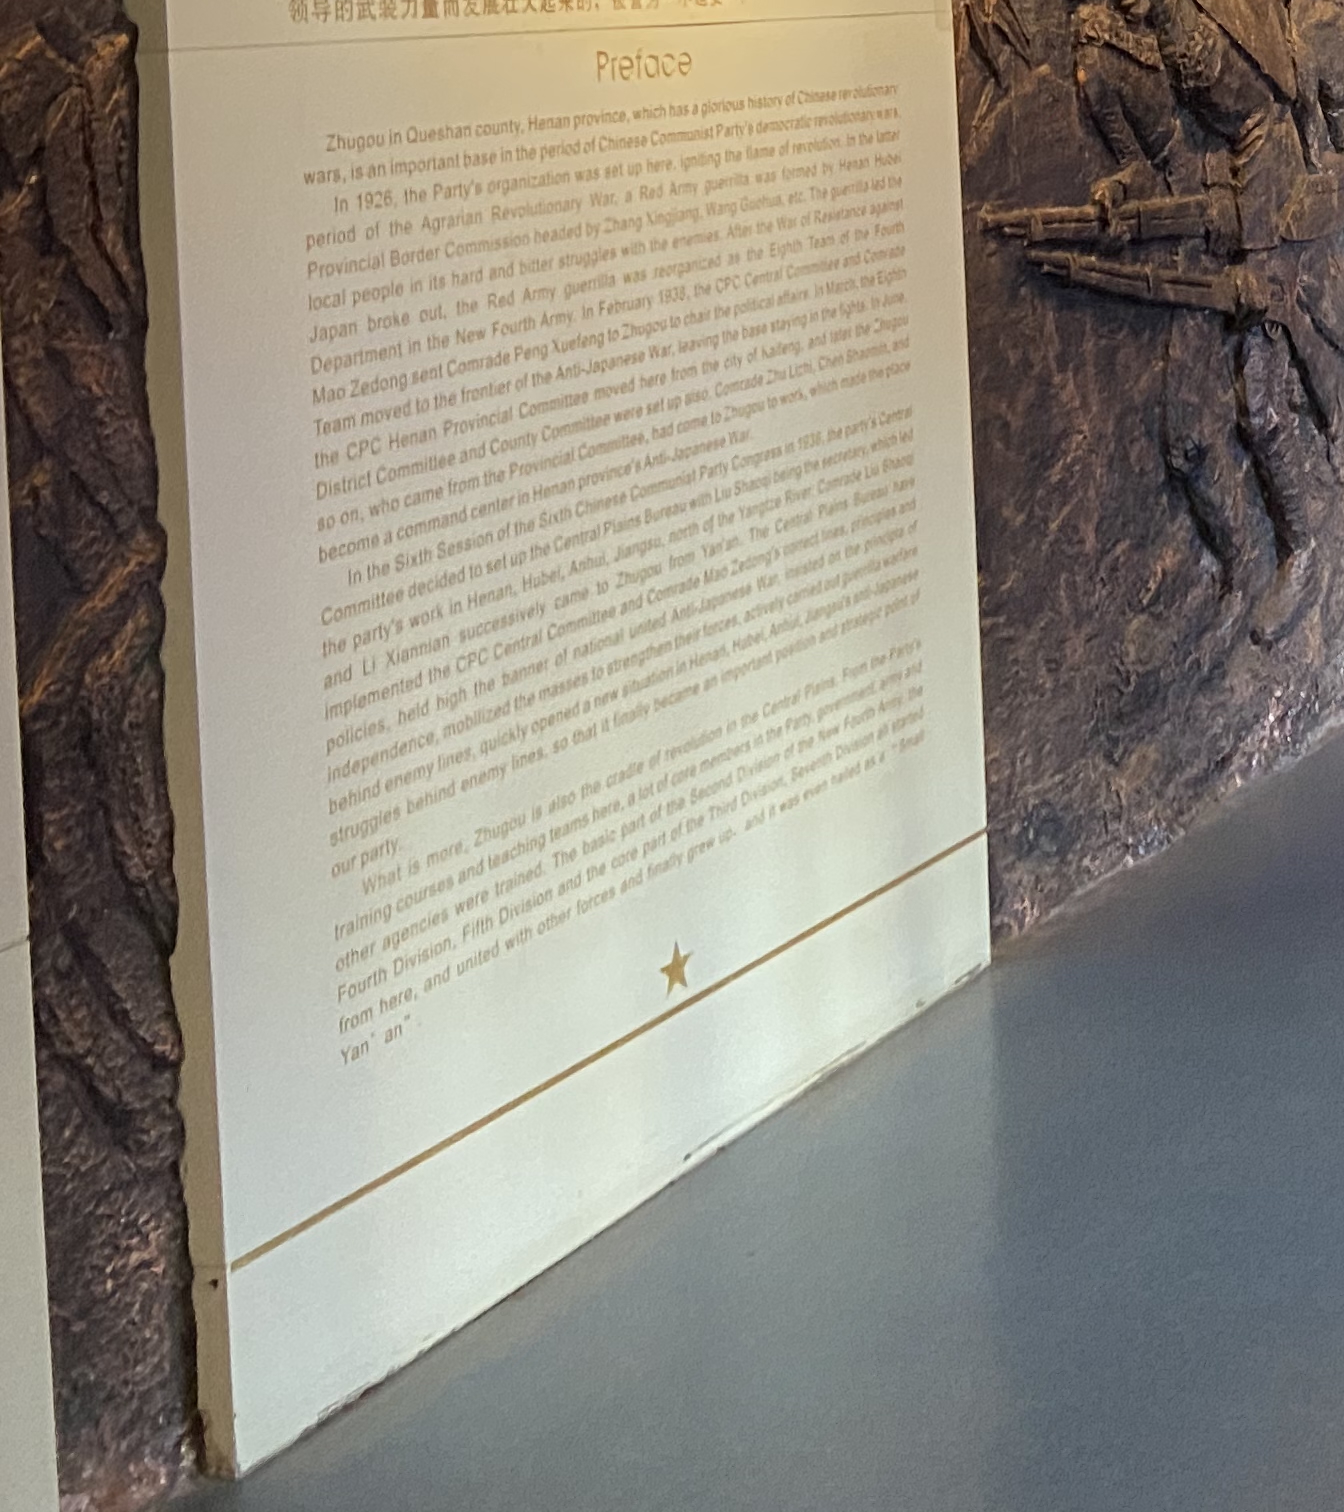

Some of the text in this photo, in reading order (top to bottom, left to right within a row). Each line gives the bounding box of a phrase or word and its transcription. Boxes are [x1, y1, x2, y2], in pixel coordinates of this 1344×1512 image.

[596, 44, 692, 83] Preface
[326, 133, 384, 153] Zhugou
[406, 123, 471, 144] Queshan
[390, 153, 459, 177] important
[463, 150, 496, 166] base
[488, 169, 569, 195] organization
[305, 224, 355, 252] period
[422, 209, 482, 234] Agrarian
[491, 198, 581, 221] Revolutionary
[307, 251, 384, 279] Provincial
[390, 245, 439, 266] Border
[445, 231, 529, 257] Commission
[307, 288, 345, 311] local
[352, 280, 403, 308] people
[309, 322, 357, 343] Japan
[368, 309, 409, 331] broke
[310, 340, 401, 373] Department
[492, 313, 535, 337] Fourth
[350, 373, 407, 396] Zedong
[412, 363, 442, 383] sent
[447, 349, 509, 376] Comrade
[314, 415, 355, 436] Team
[361, 398, 411, 425] moved
[388, 427, 436, 449] Henan
[443, 404, 512, 436] Provincial
[315, 471, 371, 499] District
[376, 453, 455, 484] Committee
[489, 431, 537, 454] County
[404, 486, 443, 507] came
[317, 534, 379, 563] become
[397, 505, 467, 540] command
[471, 496, 514, 519] center
[395, 545, 432, 571] Sixth
[437, 531, 493, 559] Session
[320, 589, 403, 626] Committee
[408, 565, 465, 598] decided
[409, 602, 443, 628] work
[386, 635, 449, 667] Xiannian
[460, 600, 545, 642] successively
[324, 670, 422, 720] implemented
[493, 627, 542, 659] Central
[398, 698, 429, 724] held
[436, 684, 466, 710] high
[443, 698, 510, 738] mobilized
[328, 778, 380, 815] behind
[385, 762, 434, 792] enemy
[480, 723, 527, 758] quickly
[329, 763, 506, 846] struggles behind enemy
[362, 864, 401, 896] What
[474, 813, 525, 846] Zhugou
[333, 904, 391, 941] training
[396, 875, 453, 912] courses
[488, 833, 545, 870] teaching
[335, 943, 375, 972] other
[383, 908, 448, 950] agencies
[455, 889, 488, 915] were
[336, 963, 386, 1003] Fourth
[462, 912, 493, 942] Fifth
[499, 888, 551, 924] Division
[338, 1007, 372, 1035] from
